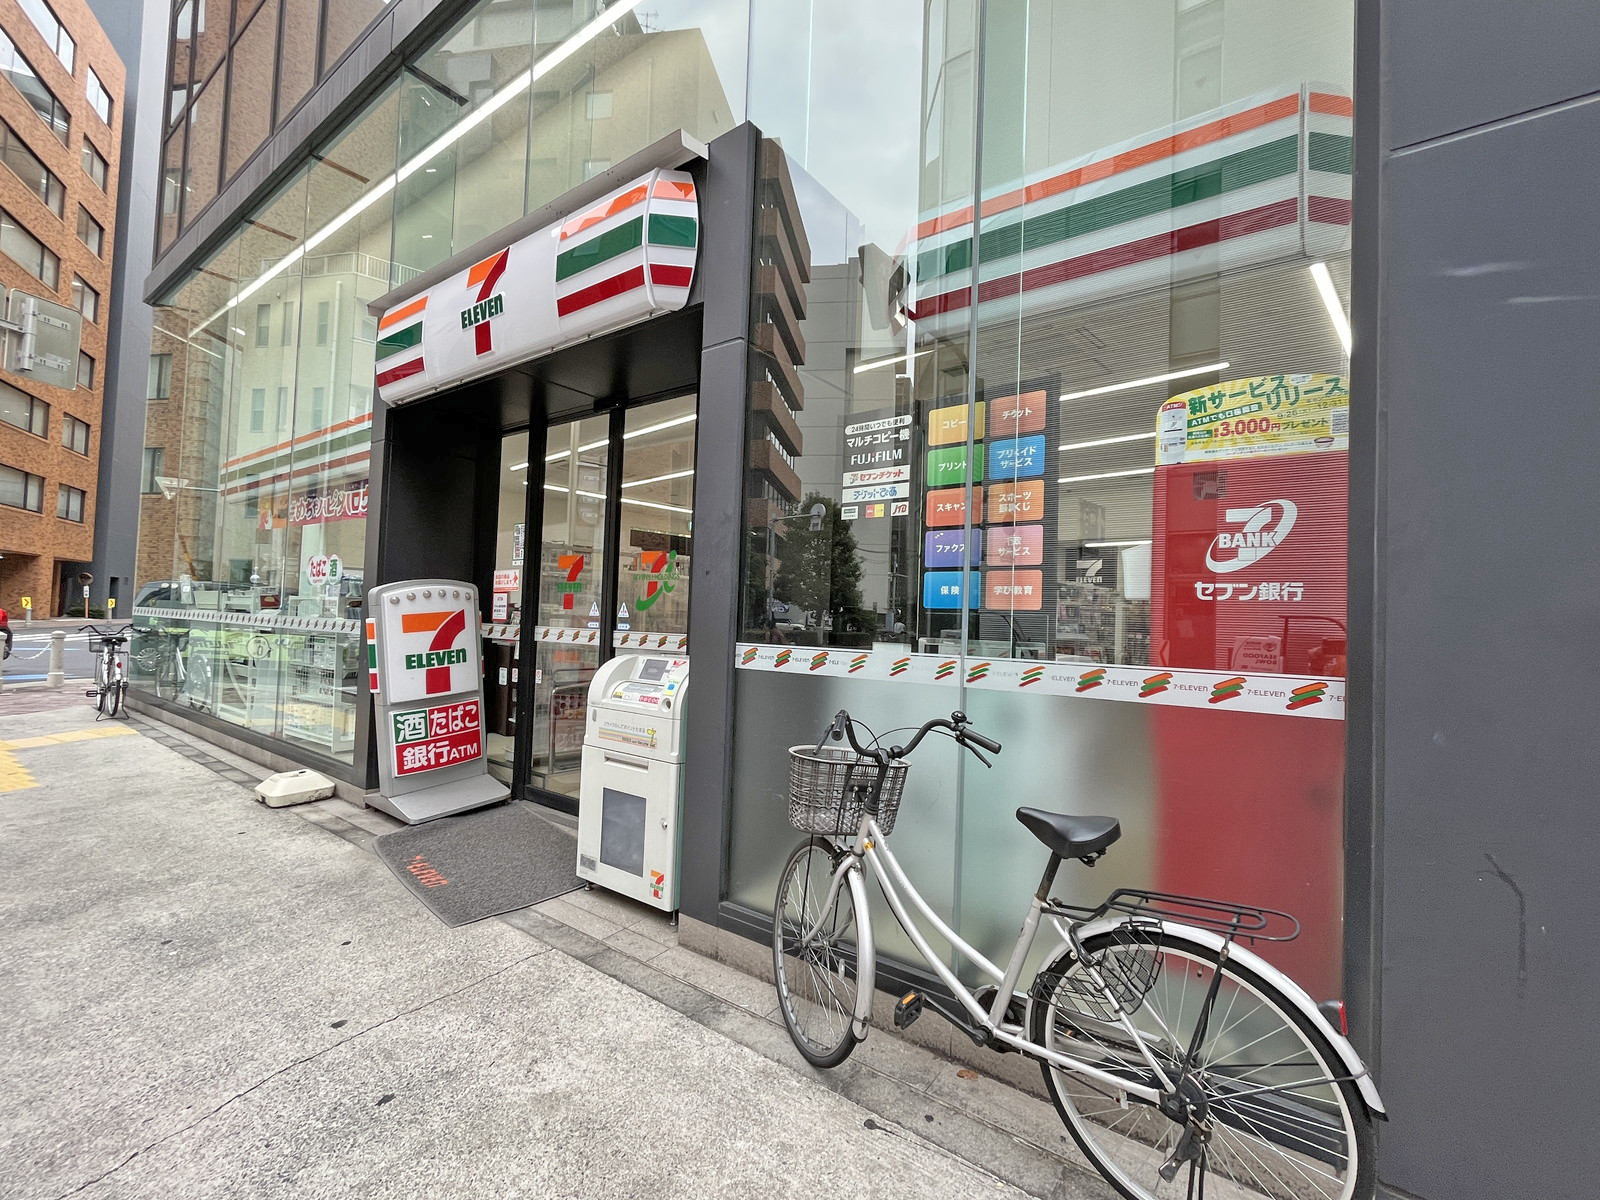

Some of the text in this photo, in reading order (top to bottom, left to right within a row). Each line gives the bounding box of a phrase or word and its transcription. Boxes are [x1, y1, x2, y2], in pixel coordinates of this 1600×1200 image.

[1188, 375, 1288, 416] 新サービス
[1266, 377, 1348, 411] リリース
[1002, 407, 1033, 420] チケット
[851, 417, 906, 433] 24時間いつでも便利
[943, 419, 967, 429] コピー
[846, 428, 910, 448] マルチコピー機
[1000, 457, 1033, 469] サービス
[859, 469, 904, 481] セブンチケット
[892, 504, 907, 515] JTB
[1218, 531, 1277, 548] BANK
[997, 547, 1031, 556] サービス
[309, 558, 338, 577] たばこ 酒
[940, 585, 960, 595] 保険
[993, 585, 1033, 596] 学び教育
[1194, 581, 1304, 601] セブン銀行
[396, 704, 479, 743] 酒 たばこ
